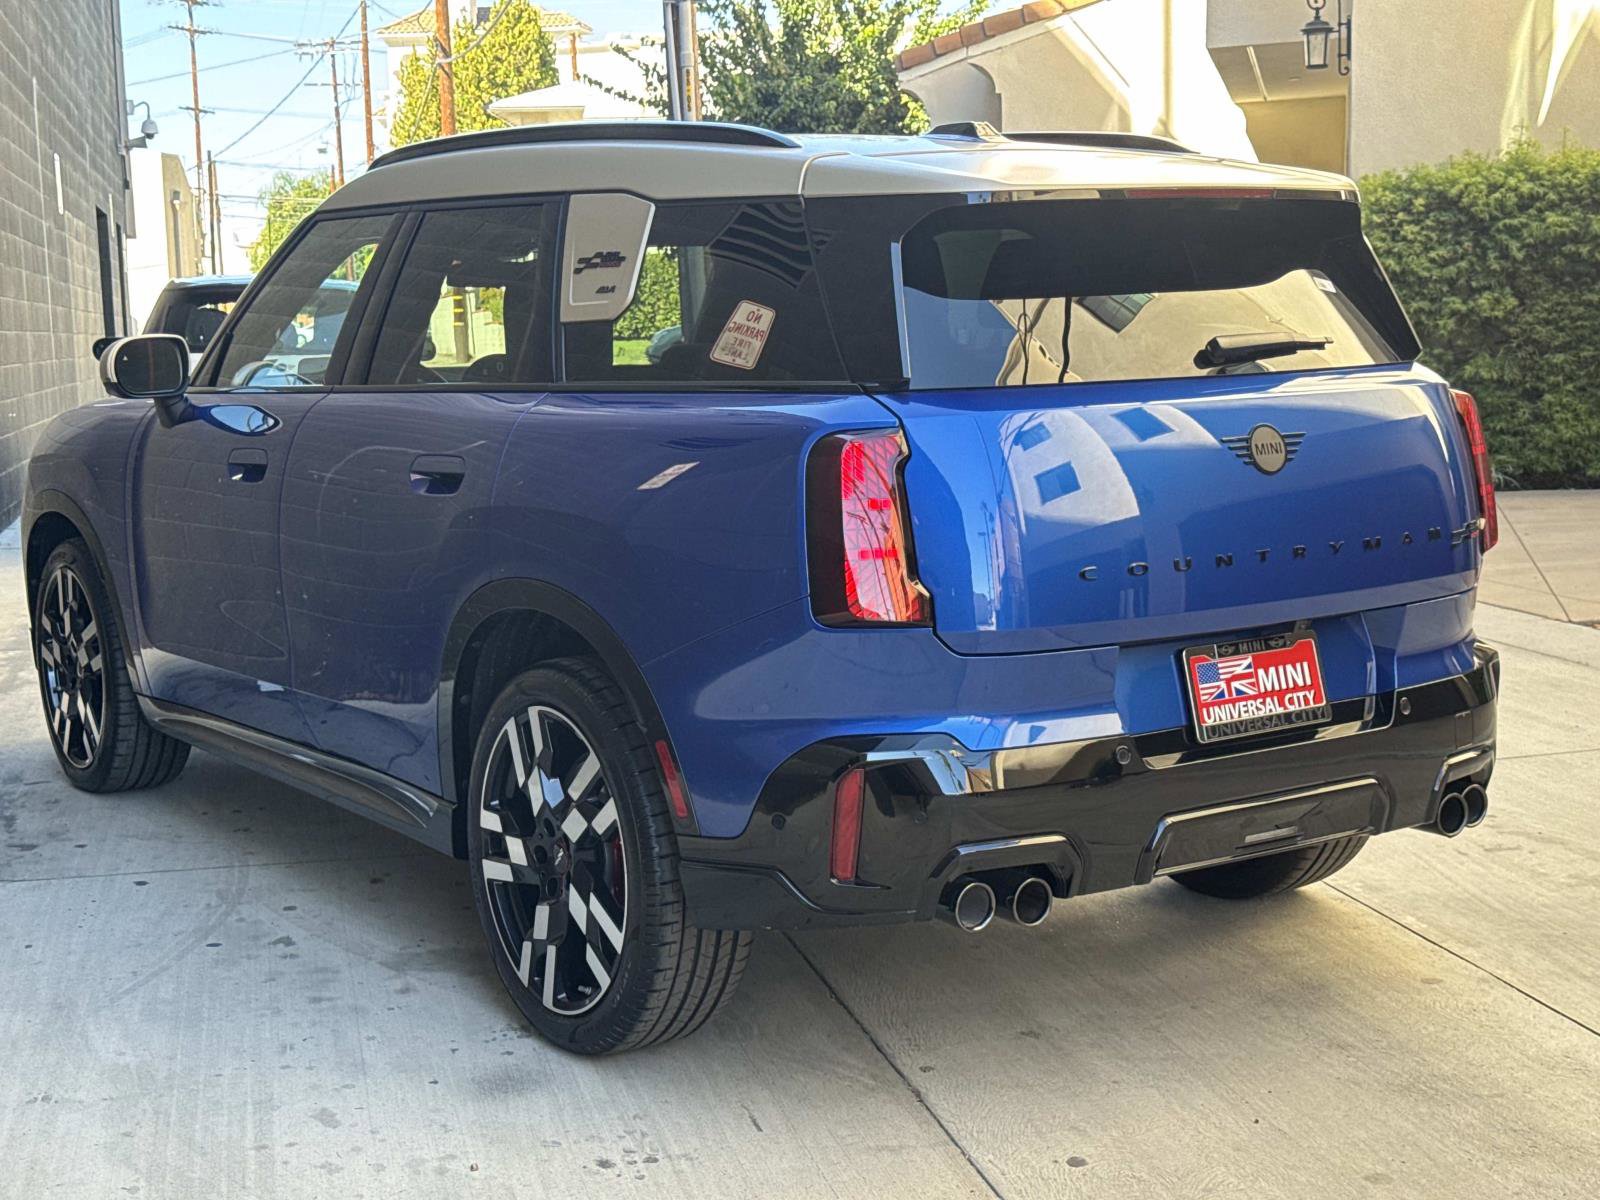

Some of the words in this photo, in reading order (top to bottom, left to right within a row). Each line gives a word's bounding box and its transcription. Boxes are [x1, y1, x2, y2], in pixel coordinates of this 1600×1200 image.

[1254, 442, 1283, 456] MINI
[1078, 526, 1441, 583] COUNTRYMAN
[1238, 639, 1266, 654] MINI
[1257, 661, 1312, 694] MINI
[1202, 695, 1284, 724] UNIVERSAL
[1284, 689, 1316, 711] CITY
[1207, 712, 1290, 738] UNIVERSAL
[1291, 707, 1324, 724] CITY
